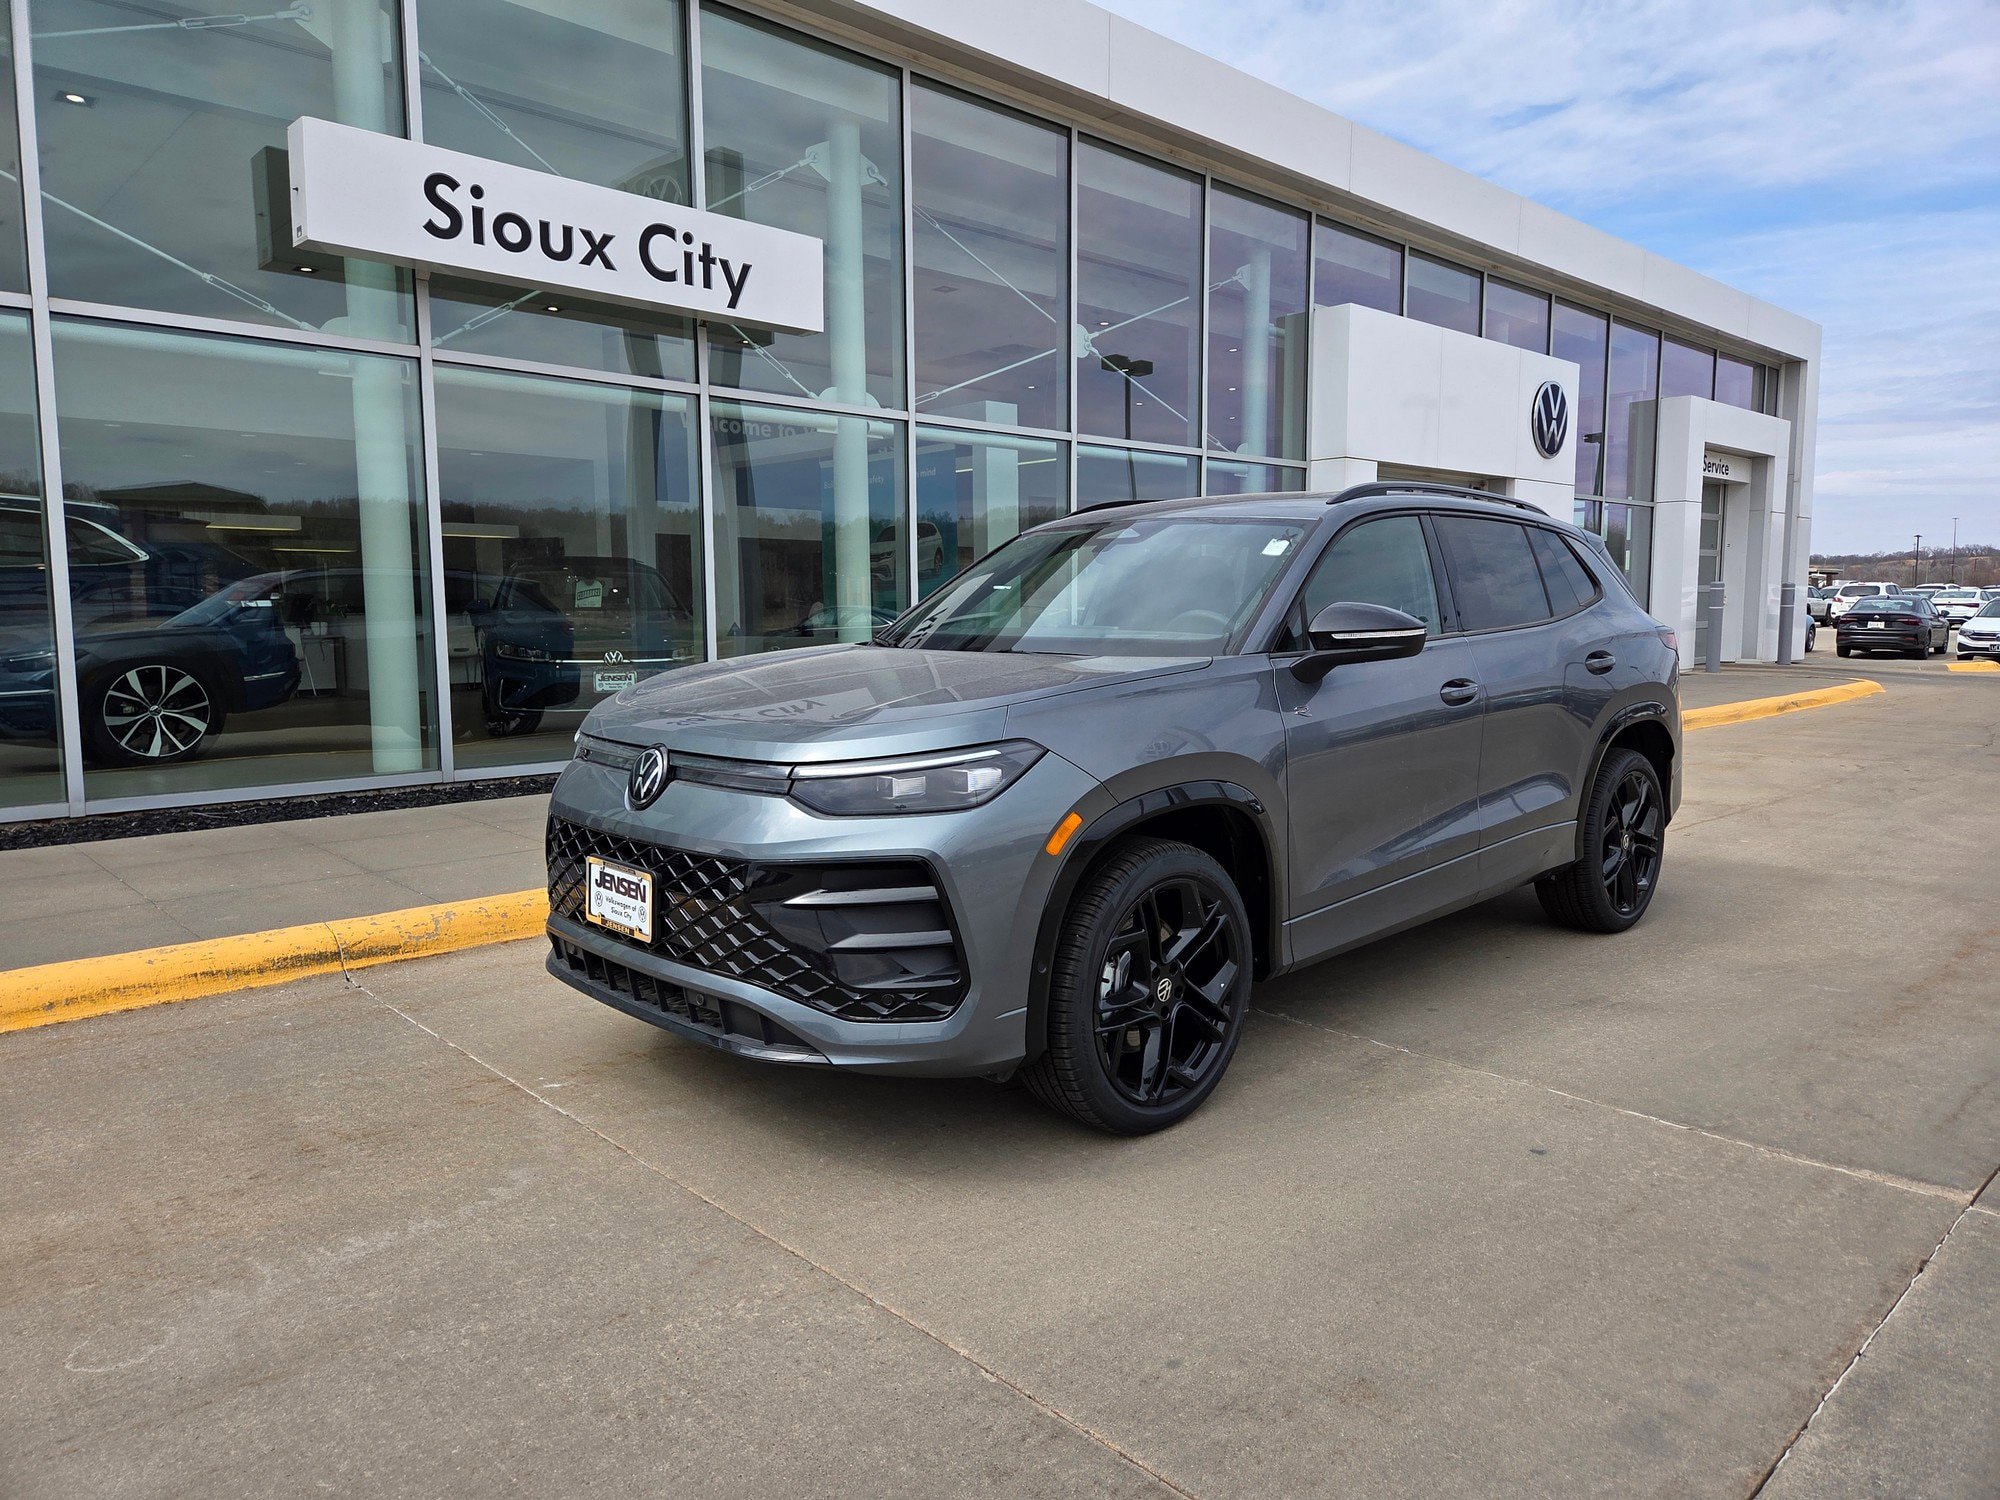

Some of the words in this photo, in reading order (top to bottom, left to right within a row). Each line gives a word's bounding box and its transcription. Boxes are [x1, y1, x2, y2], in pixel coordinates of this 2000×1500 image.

[422, 172, 618, 272] Sioux
[638, 222, 753, 310] City
[1702, 454, 1730, 476] Service
[598, 674, 632, 682] JENSEN
[595, 870, 647, 903] JENSEN
[604, 895, 632, 911] Volkswagen
[605, 920, 630, 934] JENSEN
